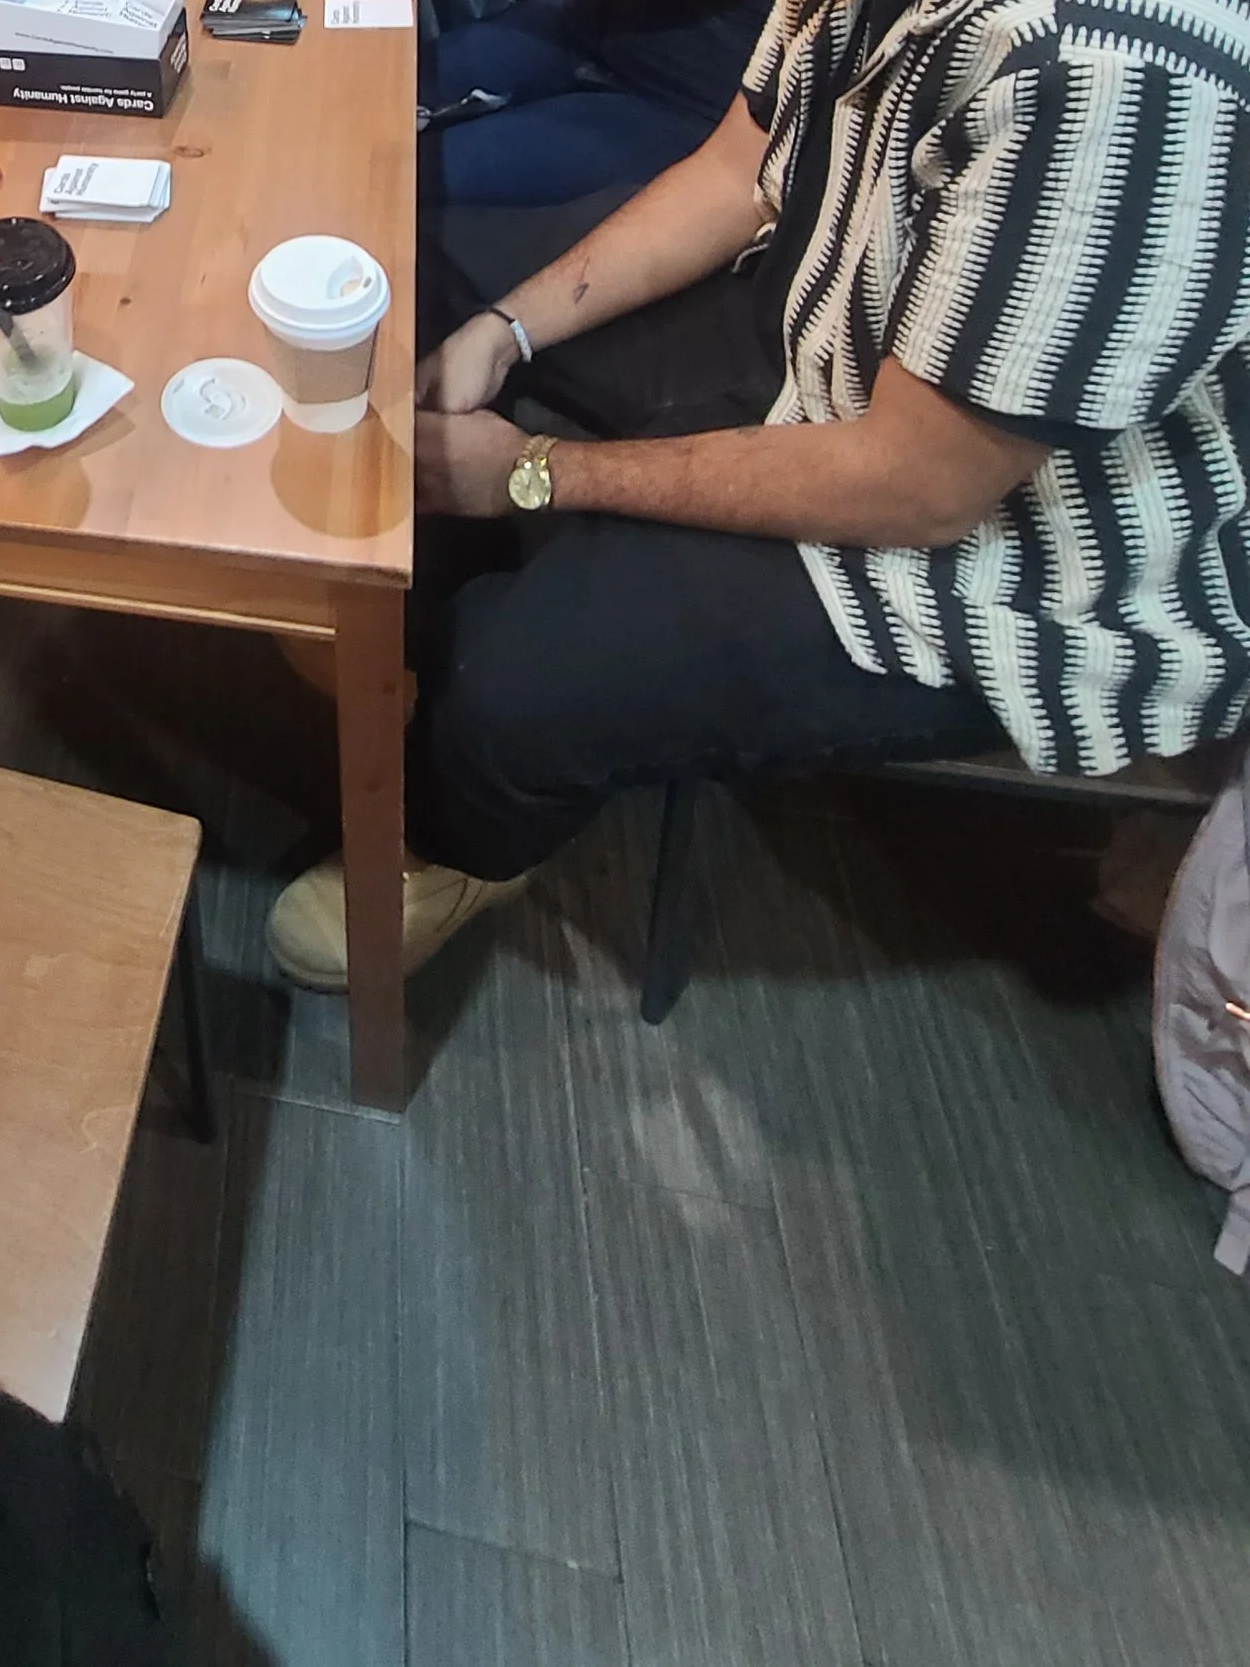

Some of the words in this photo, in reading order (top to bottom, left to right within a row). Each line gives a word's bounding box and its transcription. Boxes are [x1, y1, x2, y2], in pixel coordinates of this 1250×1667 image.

[13, 87, 68, 104] Humanity
[70, 94, 114, 108] Against
[117, 97, 154, 111] Cards
